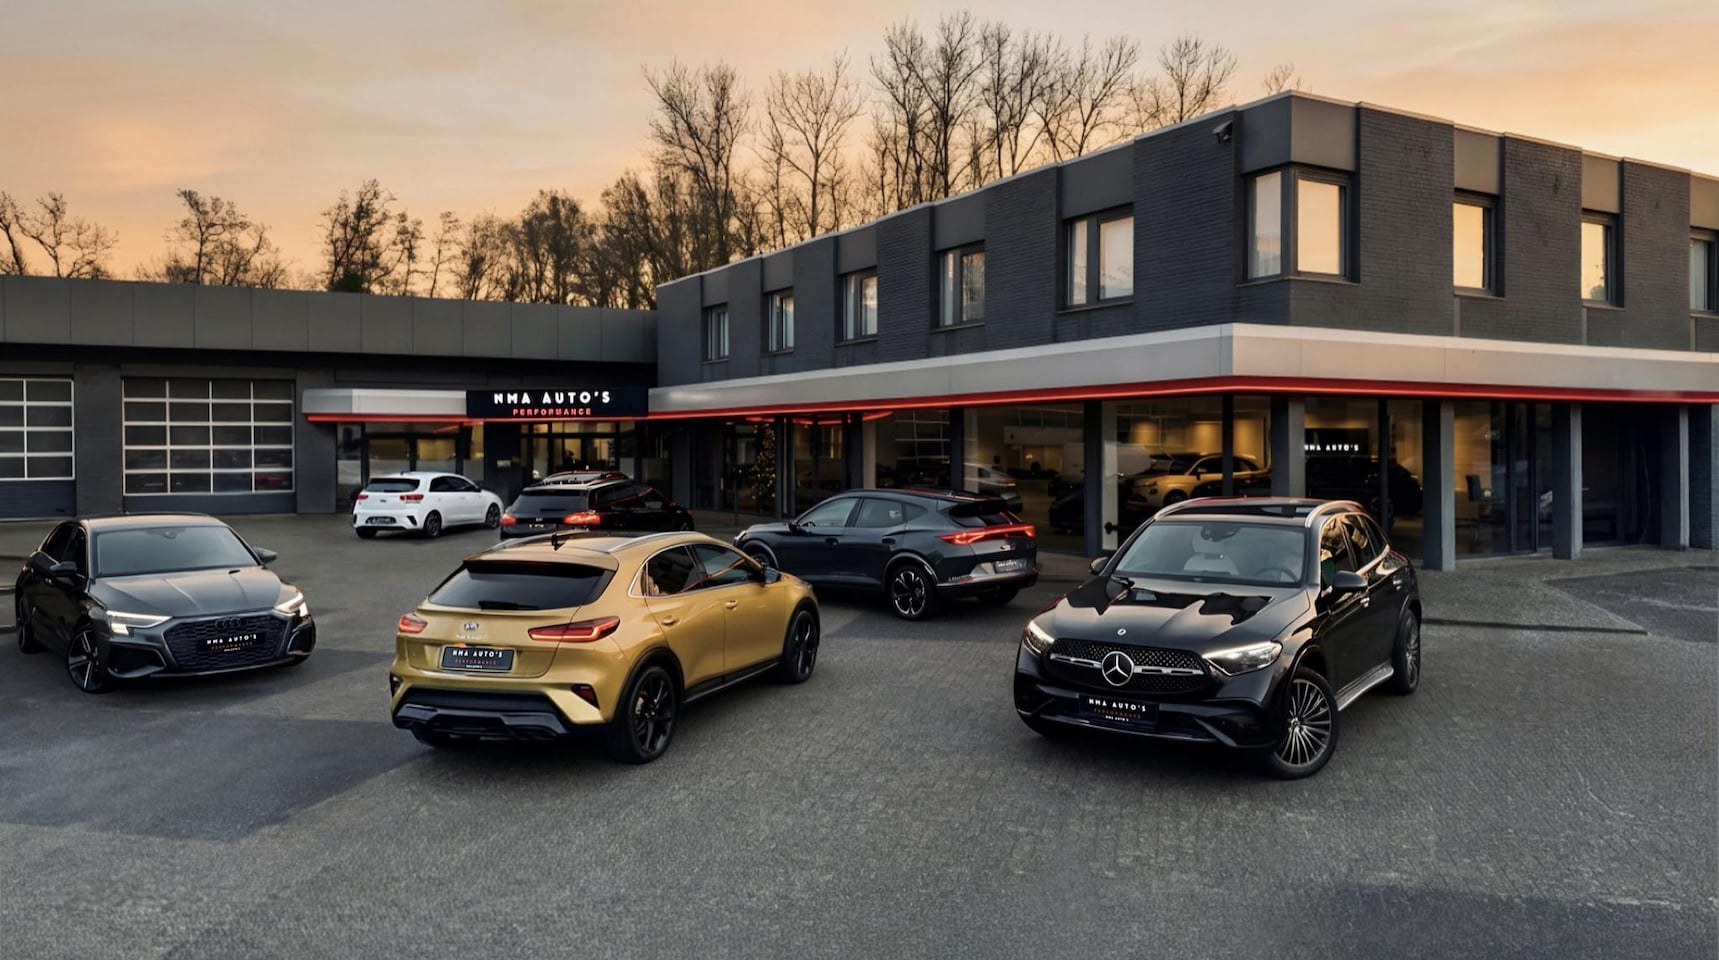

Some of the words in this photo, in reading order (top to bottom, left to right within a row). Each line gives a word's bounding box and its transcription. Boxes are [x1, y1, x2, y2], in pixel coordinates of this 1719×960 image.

[494, 392, 531, 405] NMA
[542, 391, 611, 404] AUTO'S
[513, 408, 591, 416] PERFORMANCE
